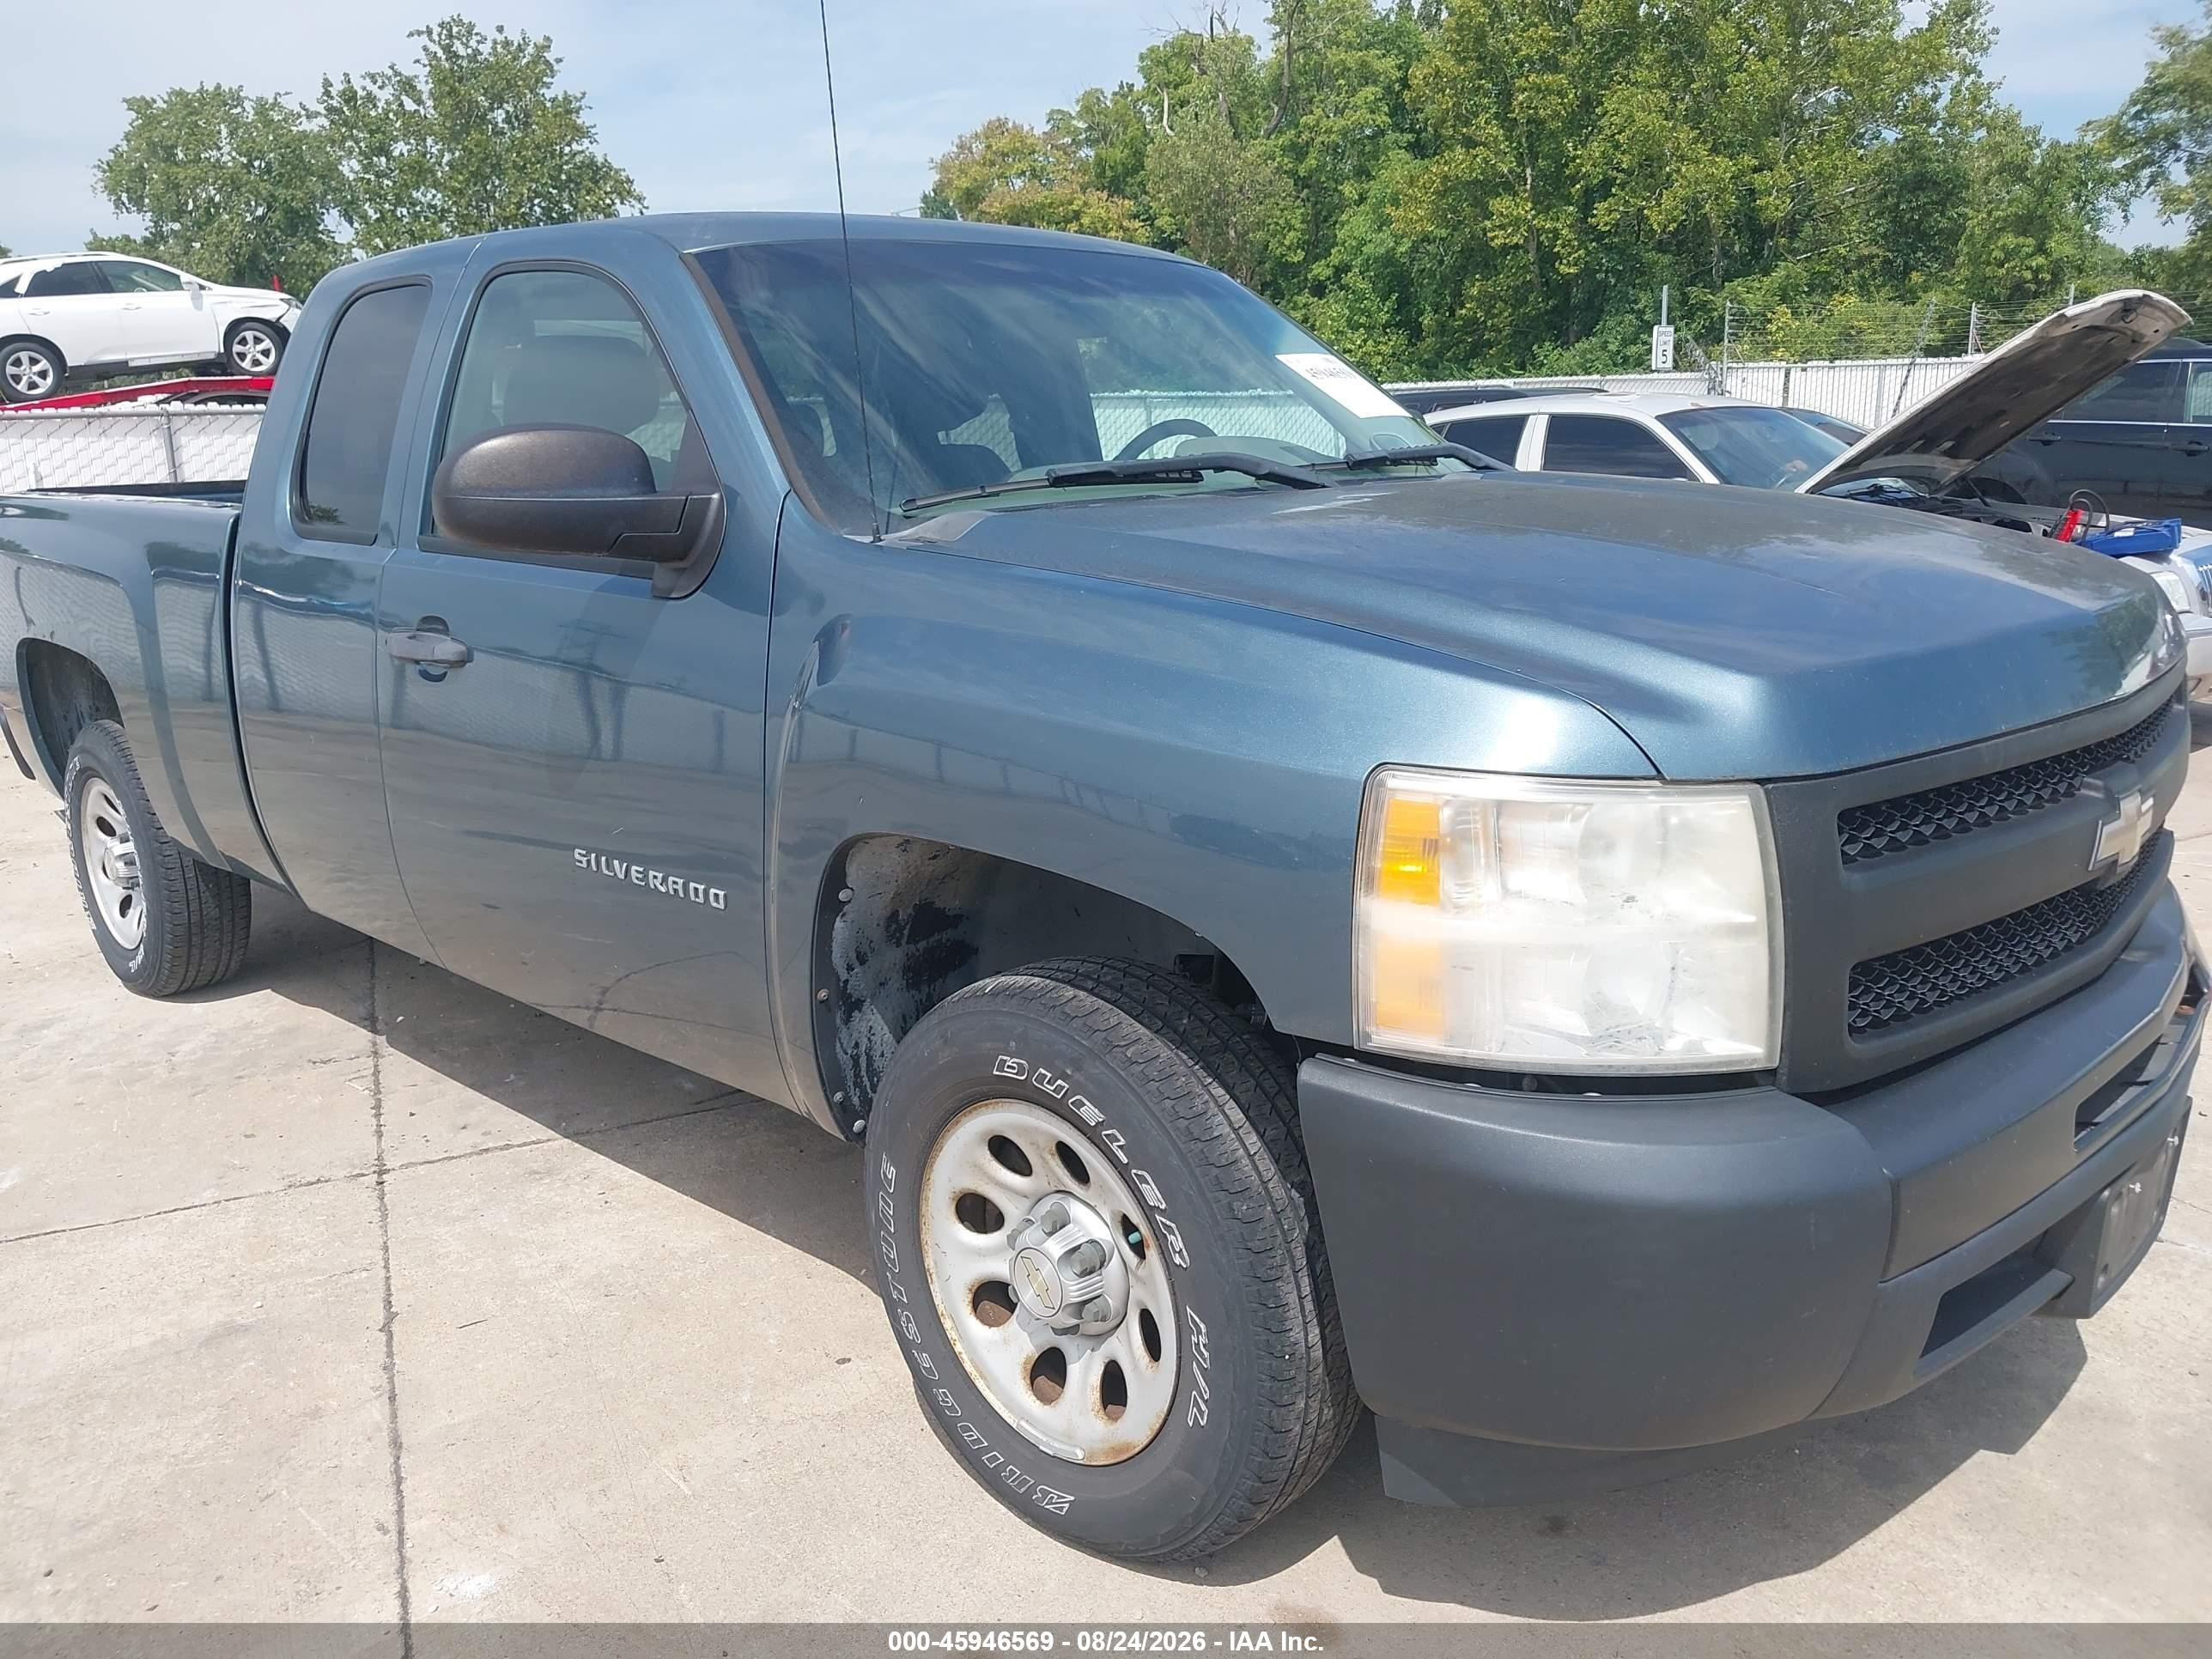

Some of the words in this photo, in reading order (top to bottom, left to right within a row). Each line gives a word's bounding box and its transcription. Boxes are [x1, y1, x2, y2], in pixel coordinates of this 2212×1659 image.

[1661, 349, 1668, 364] 5
[574, 848, 727, 910] SILVERADO
[992, 1054, 1191, 1271] DUELER
[878, 1152, 1077, 1516] BRIDGESTONE
